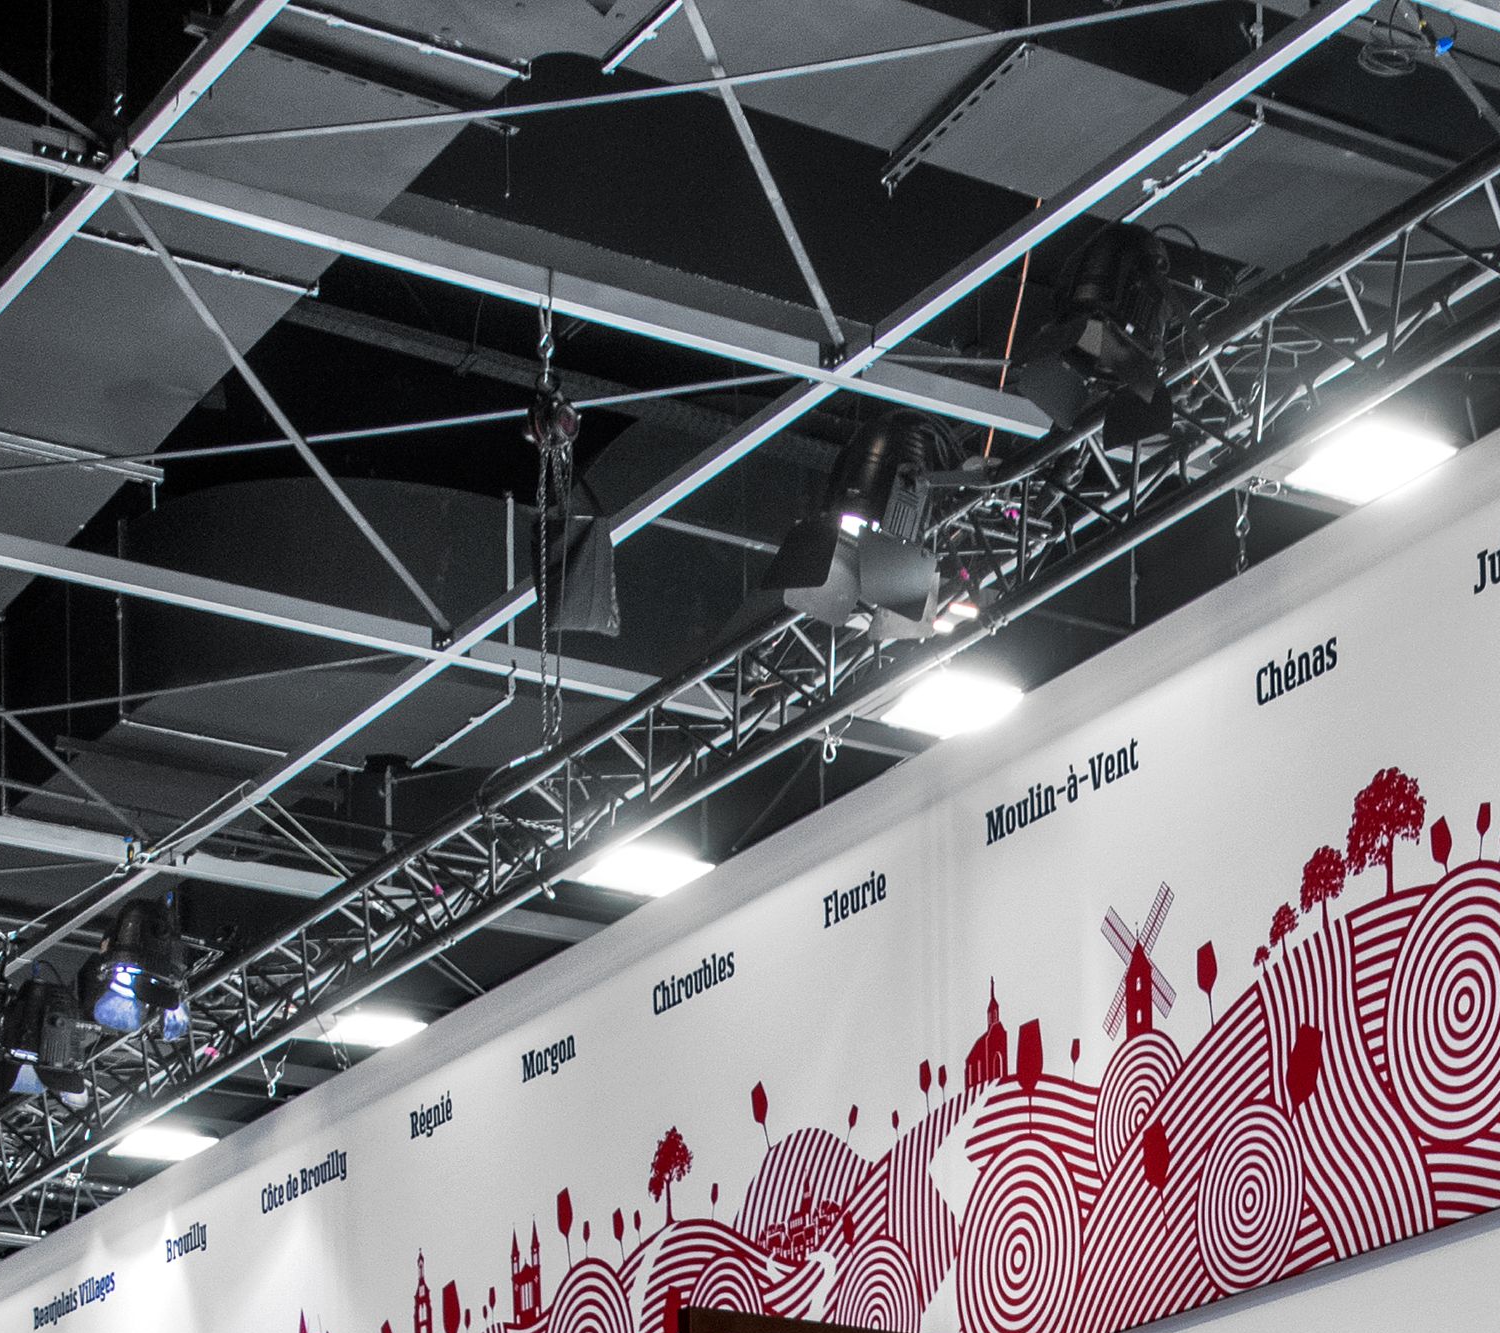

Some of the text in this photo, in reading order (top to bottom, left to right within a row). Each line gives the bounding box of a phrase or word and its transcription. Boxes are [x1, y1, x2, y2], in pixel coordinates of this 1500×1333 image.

[1256, 636, 1338, 706] Chénas
[985, 739, 1139, 845] Moulin-à-Vent
[823, 870, 887, 929] Fleurie
[652, 951, 735, 1016] Chiroubles
[522, 1034, 576, 1083] Morgon
[410, 1091, 453, 1140] Régnié
[261, 1149, 347, 1214] Côte de Brouilly
[166, 1222, 207, 1263] Brouilly
[33, 1271, 115, 1330] Beaujolais Villages
